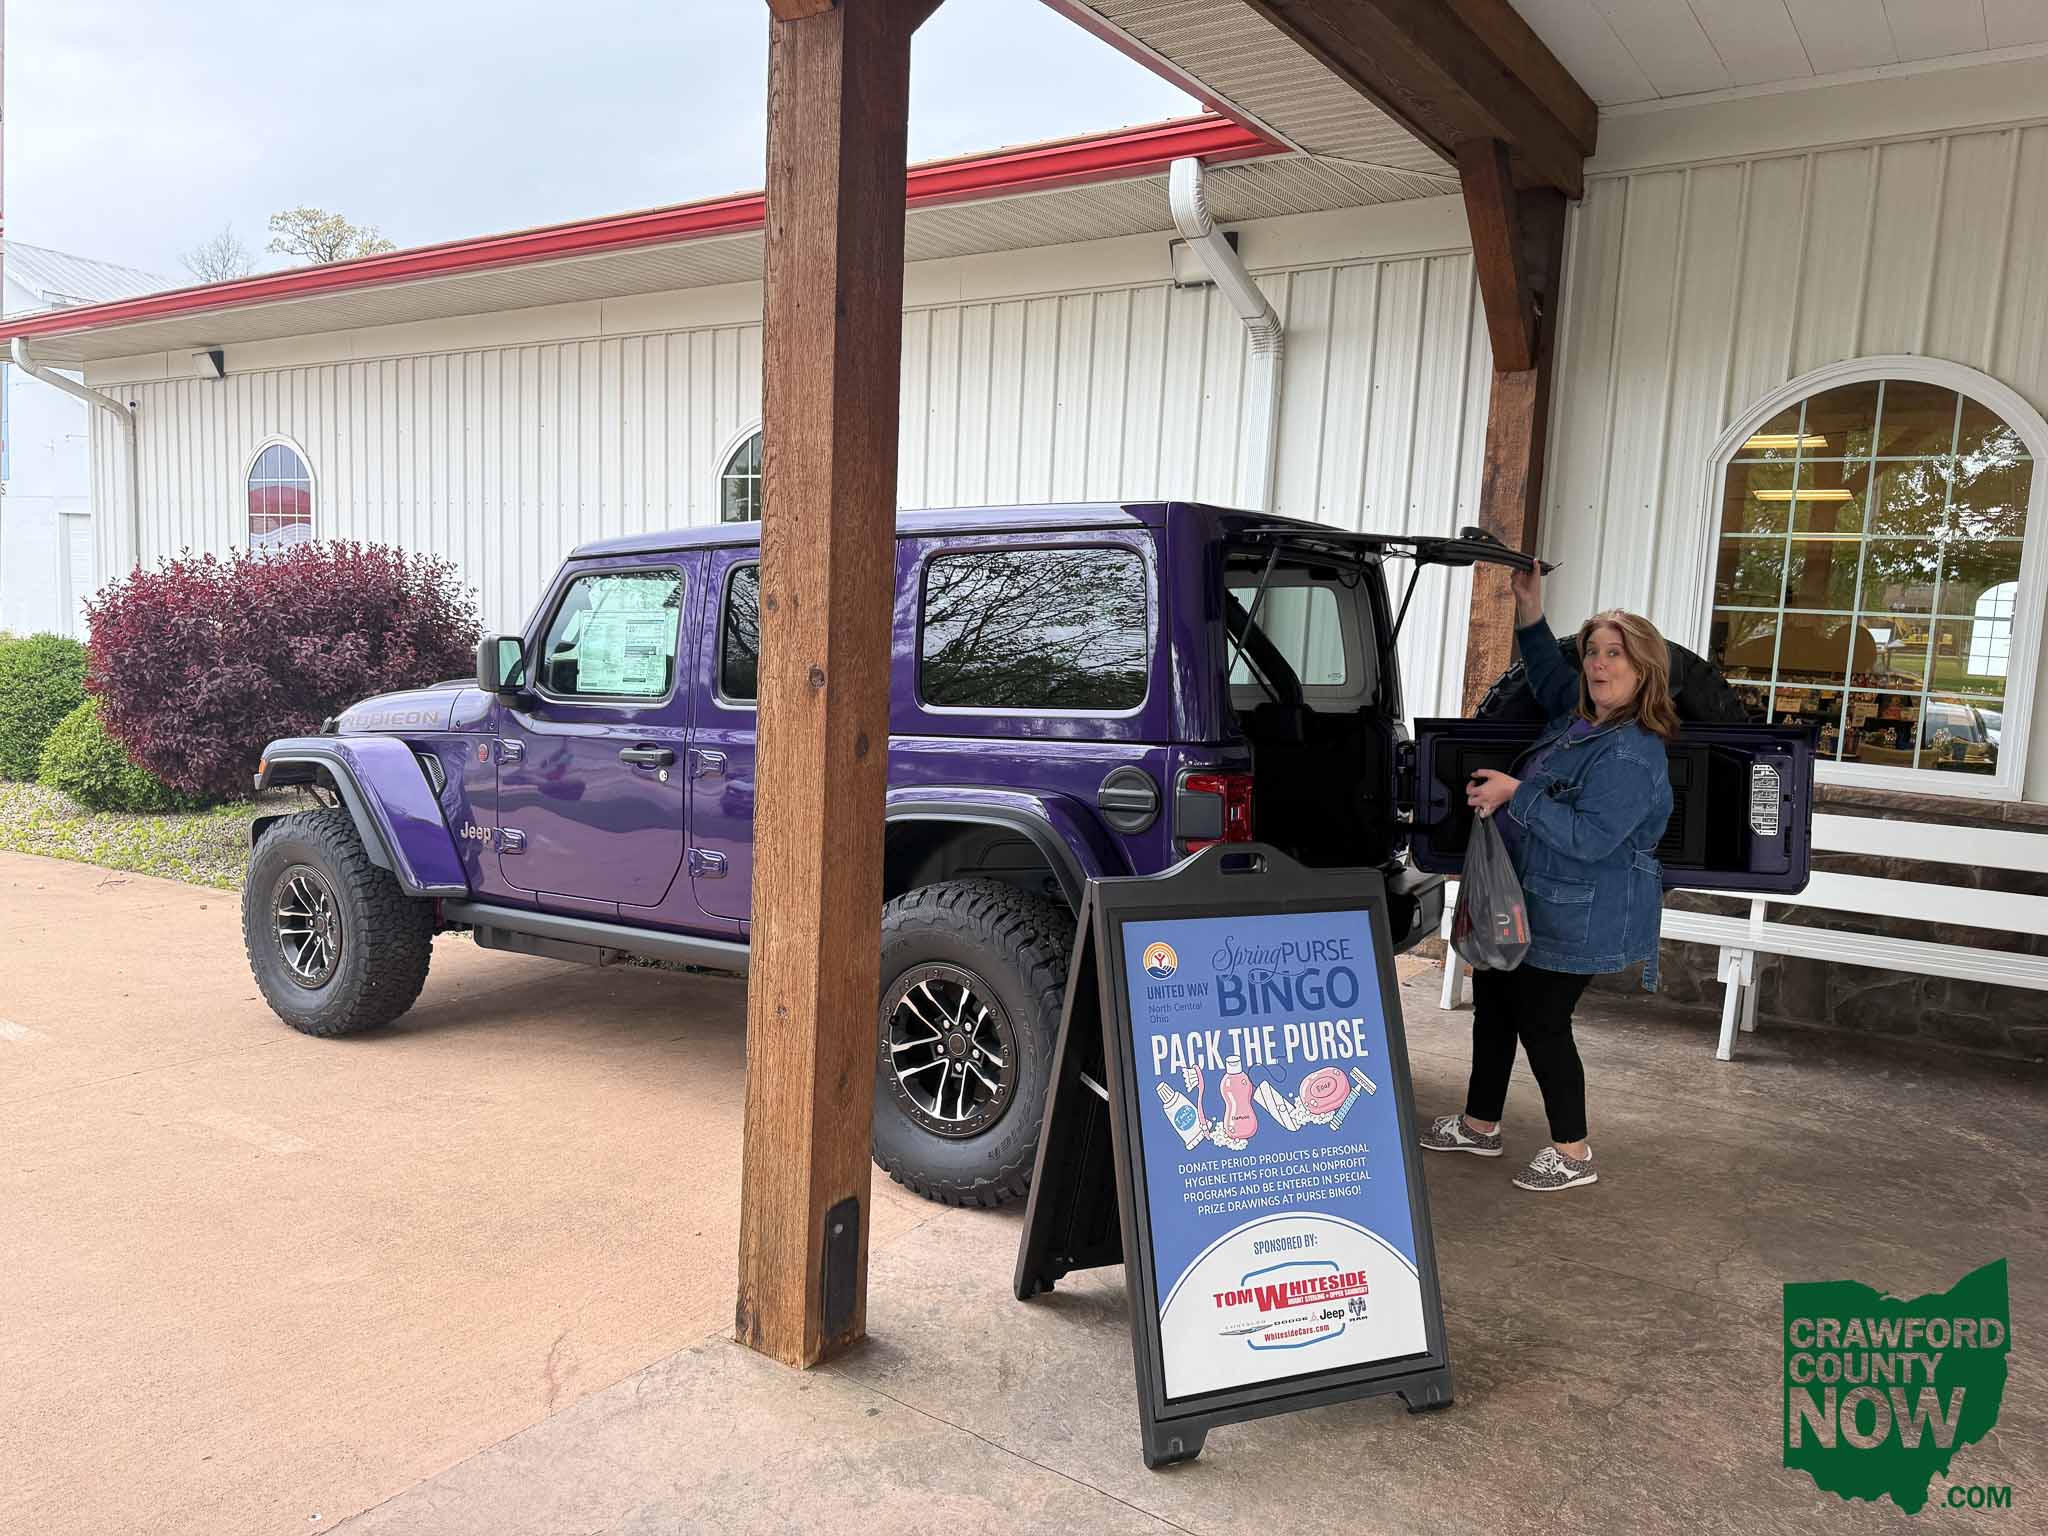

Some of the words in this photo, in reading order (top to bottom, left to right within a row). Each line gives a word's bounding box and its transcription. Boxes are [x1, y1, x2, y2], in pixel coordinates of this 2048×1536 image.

[460, 821, 492, 843] Jeep
[1212, 936, 1284, 980] Spring
[1282, 939, 1353, 964] PURSE
[1147, 984, 1185, 1000] UNITED
[1187, 982, 1208, 997] WAY
[1216, 966, 1359, 1017] BINGO
[1148, 1003, 1172, 1014] North
[1174, 1002, 1203, 1012] Central
[1150, 1014, 1169, 1024] Ohio
[1152, 1028, 1225, 1076] PACK
[1229, 1024, 1277, 1066] THE
[1284, 1018, 1369, 1064] PURSE
[1178, 1159, 1219, 1175] DONATE
[1221, 1155, 1257, 1171] PERIOD
[1259, 1150, 1310, 1166] PRODUCTS
[1312, 1148, 1319, 1158] &
[1321, 1143, 1369, 1158] PERSONAL
[1185, 1174, 1227, 1189] HYGIENE
[1229, 1171, 1257, 1184] ITEMS
[1259, 1168, 1279, 1180] FOR
[1280, 1164, 1311, 1176] LOCAL
[1312, 1157, 1366, 1172] NONPROFIT
[1184, 1187, 1238, 1203] PROGRAMS
[1239, 1184, 1260, 1196] AND
[1263, 1181, 1275, 1192] BE
[1277, 1176, 1320, 1191] ENTERED
[1322, 1174, 1333, 1185] IN
[1334, 1169, 1371, 1184] SPECIAL
[1198, 1202, 1226, 1216] PRIZE
[1228, 1196, 1281, 1212] DRAWINGS
[1282, 1193, 1294, 1204] AT
[1296, 1190, 1327, 1205] PURSE
[1329, 1185, 1361, 1199] BINGO!
[1253, 1235, 1303, 1255] SPONSORED
[1304, 1233, 1318, 1248] BY:
[1214, 1288, 1254, 1309] TOM
[1254, 1270, 1368, 1312] WHITESIDE
[1320, 1307, 1345, 1321] Jeep
[1264, 1324, 1330, 1342] WhitesideCars.com
